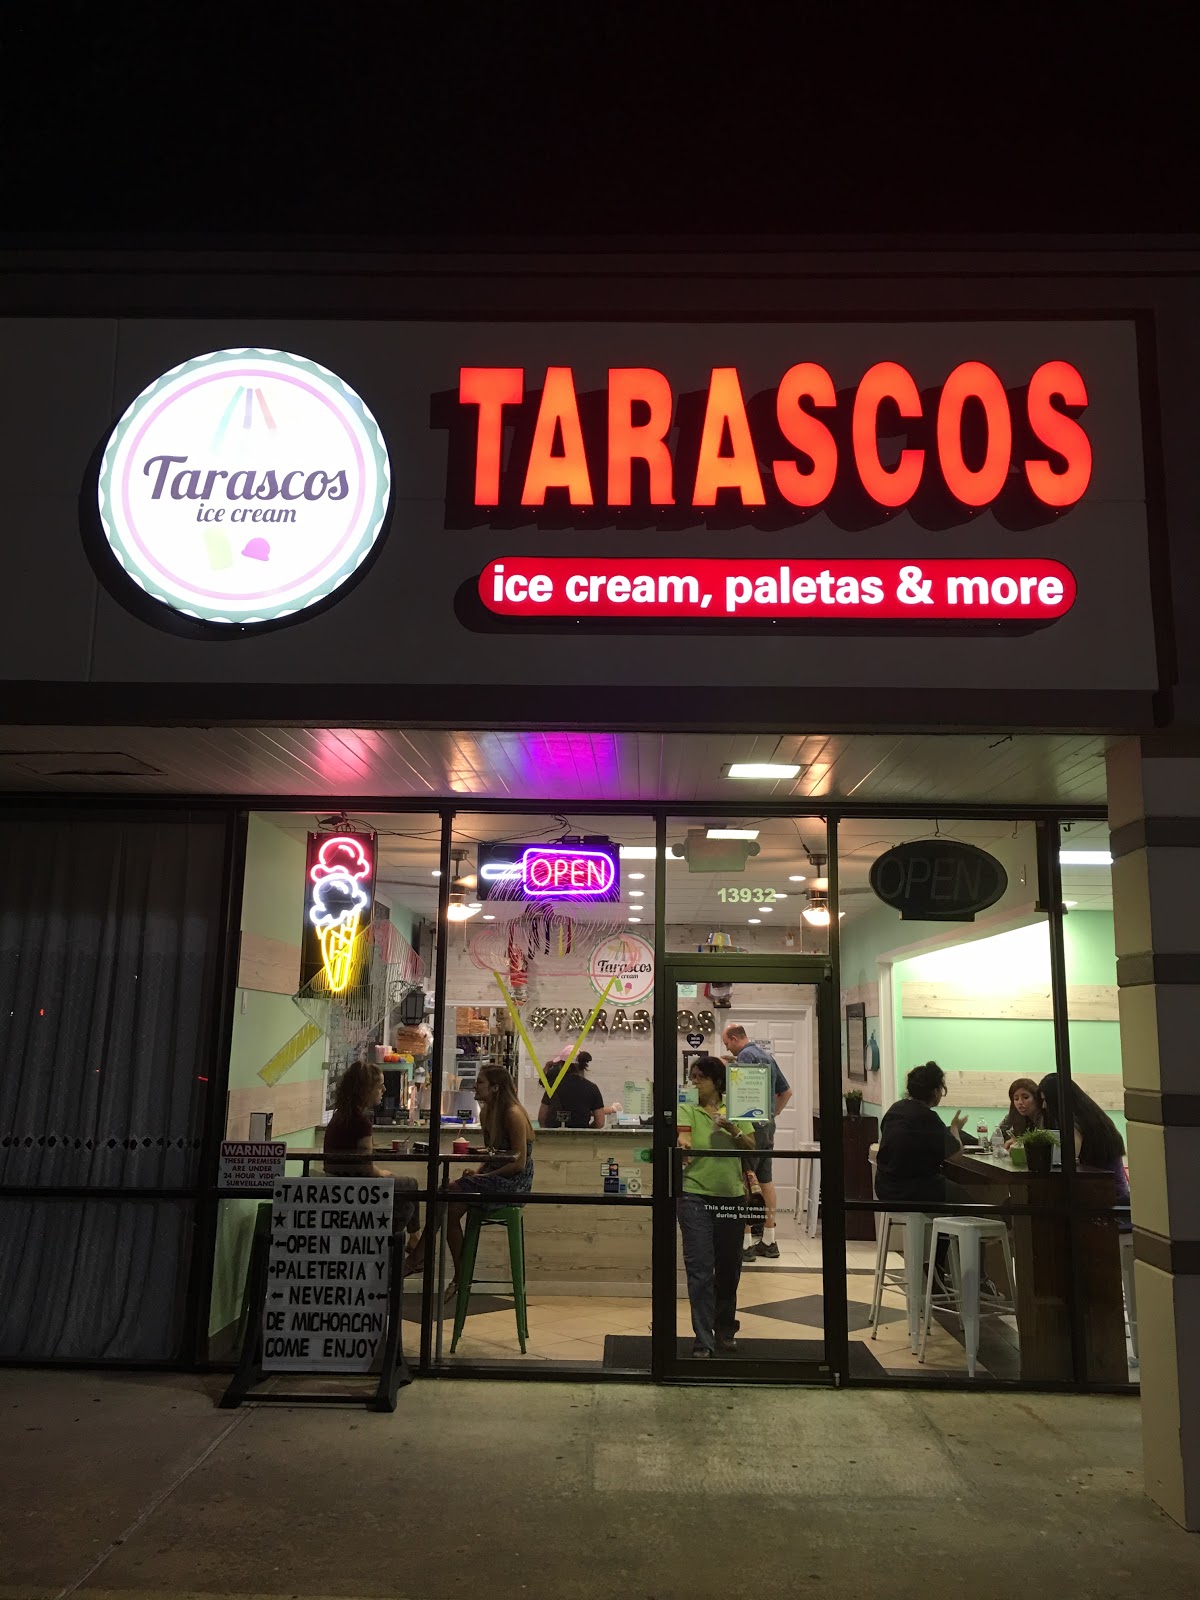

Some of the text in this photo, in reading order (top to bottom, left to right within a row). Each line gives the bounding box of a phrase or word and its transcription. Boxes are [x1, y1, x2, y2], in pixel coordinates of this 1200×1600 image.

[459, 361, 1093, 507] TARASCOS
[143, 455, 350, 501] Tarascos
[196, 503, 297, 523] ice cream
[493, 564, 1064, 612] ice cream, paletas & more
[531, 859, 604, 886] OPEN
[878, 858, 982, 901] OPEN
[717, 887, 777, 903] 13932
[531, 1007, 715, 1034] #TARASOS
[224, 1145, 283, 1155] WARNING
[282, 1185, 381, 1205] TARASCOS
[293, 1210, 375, 1230] ICE CREAM
[286, 1234, 385, 1255] OPEN DAILY
[275, 1260, 385, 1281] PALETERIA Y
[289, 1286, 366, 1306] NEVERIA
[266, 1311, 383, 1333] DE MICHOACAN
[264, 1337, 378, 1358] COME ENJOY
